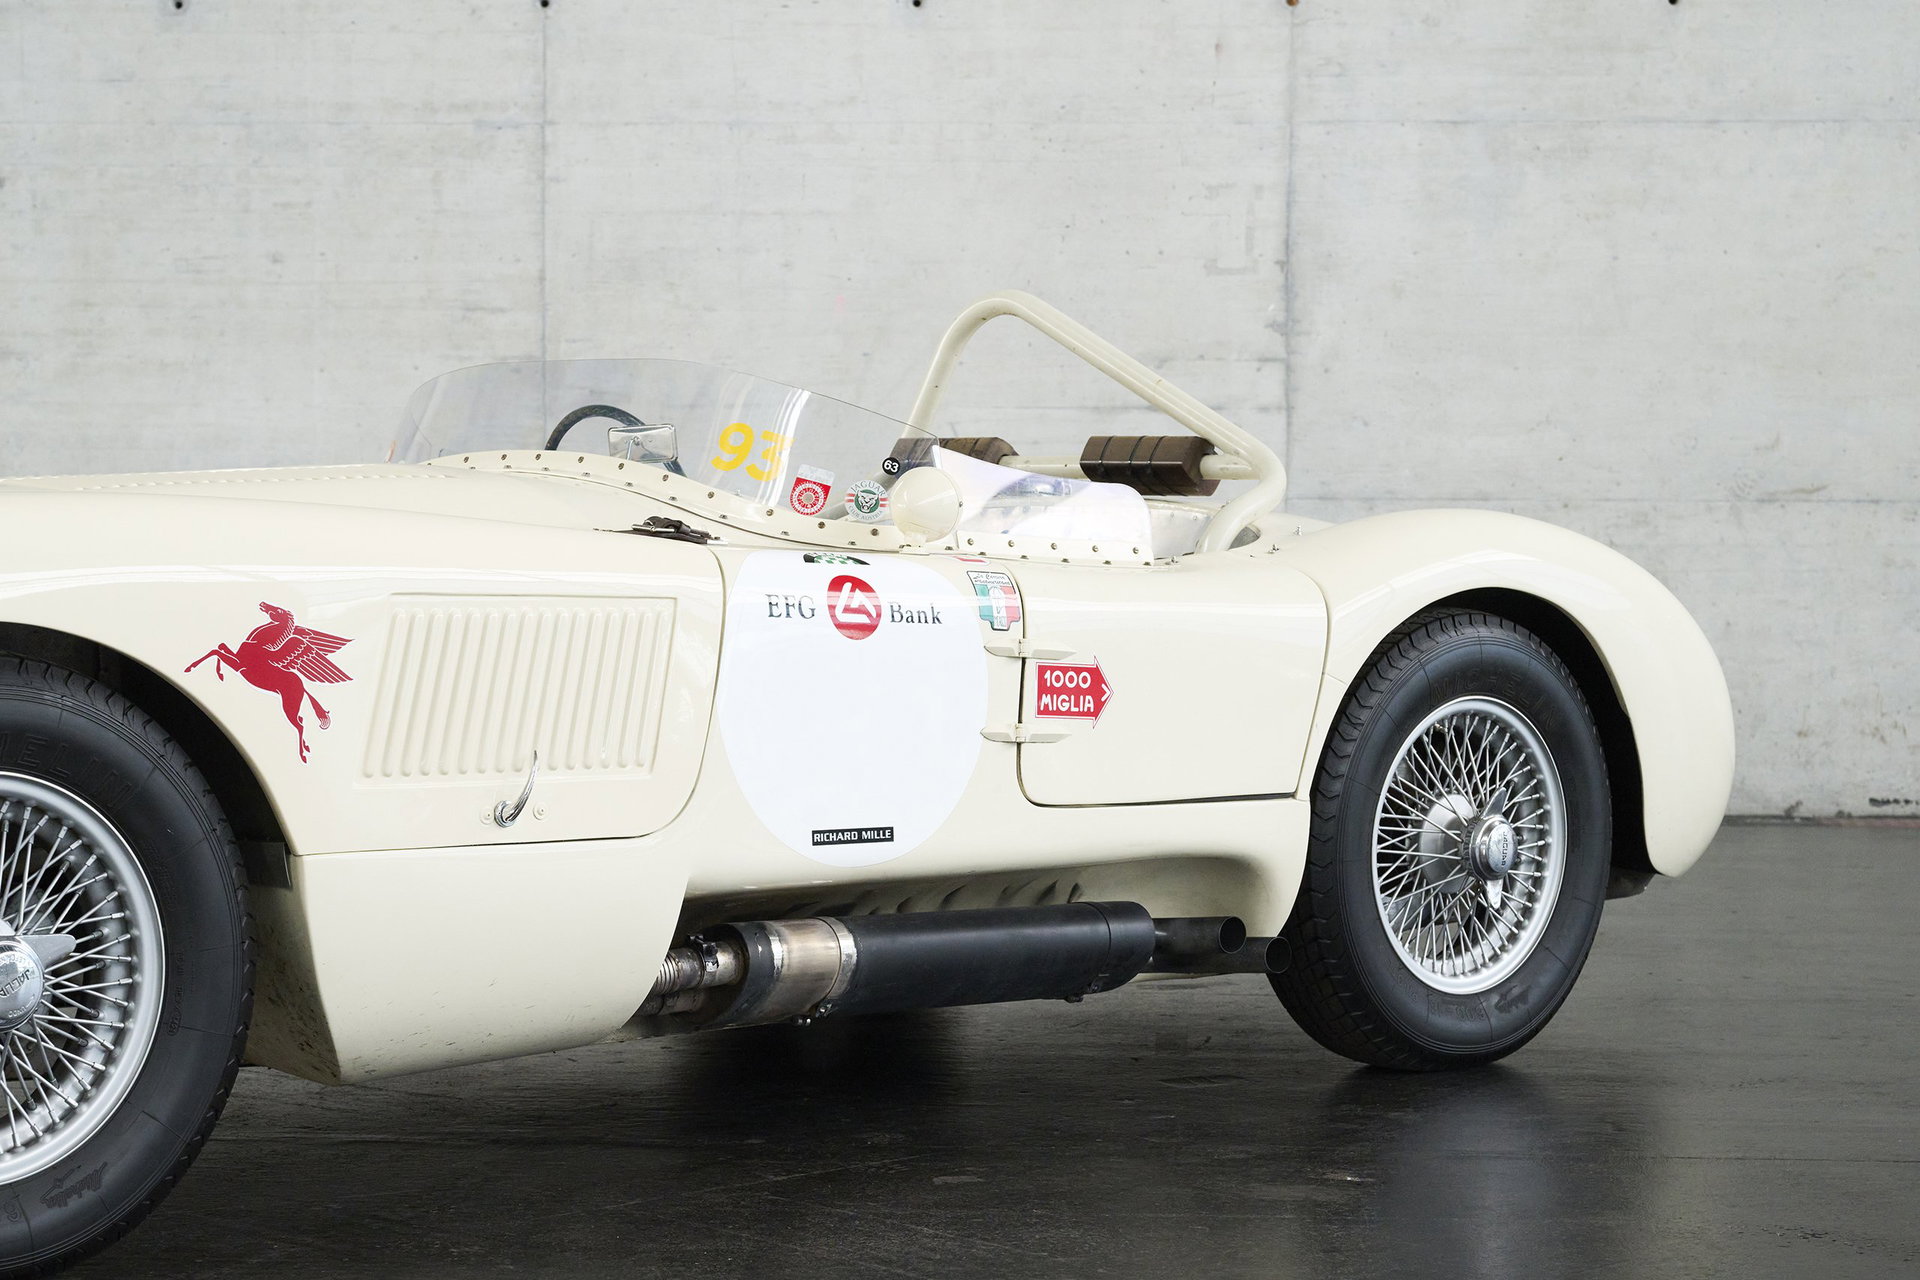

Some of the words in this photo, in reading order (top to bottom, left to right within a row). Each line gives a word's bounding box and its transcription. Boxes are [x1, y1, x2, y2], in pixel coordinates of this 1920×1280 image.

[711, 422, 794, 482] 93
[883, 459, 899, 473] 63
[850, 480, 886, 497] JAGUAR
[765, 594, 816, 619] EFG
[890, 602, 943, 625] Bank
[1043, 669, 1092, 689] 1000
[1040, 693, 1094, 712] MIGLIA
[813, 830, 859, 844] RICHARD
[861, 829, 892, 841] MILLE
